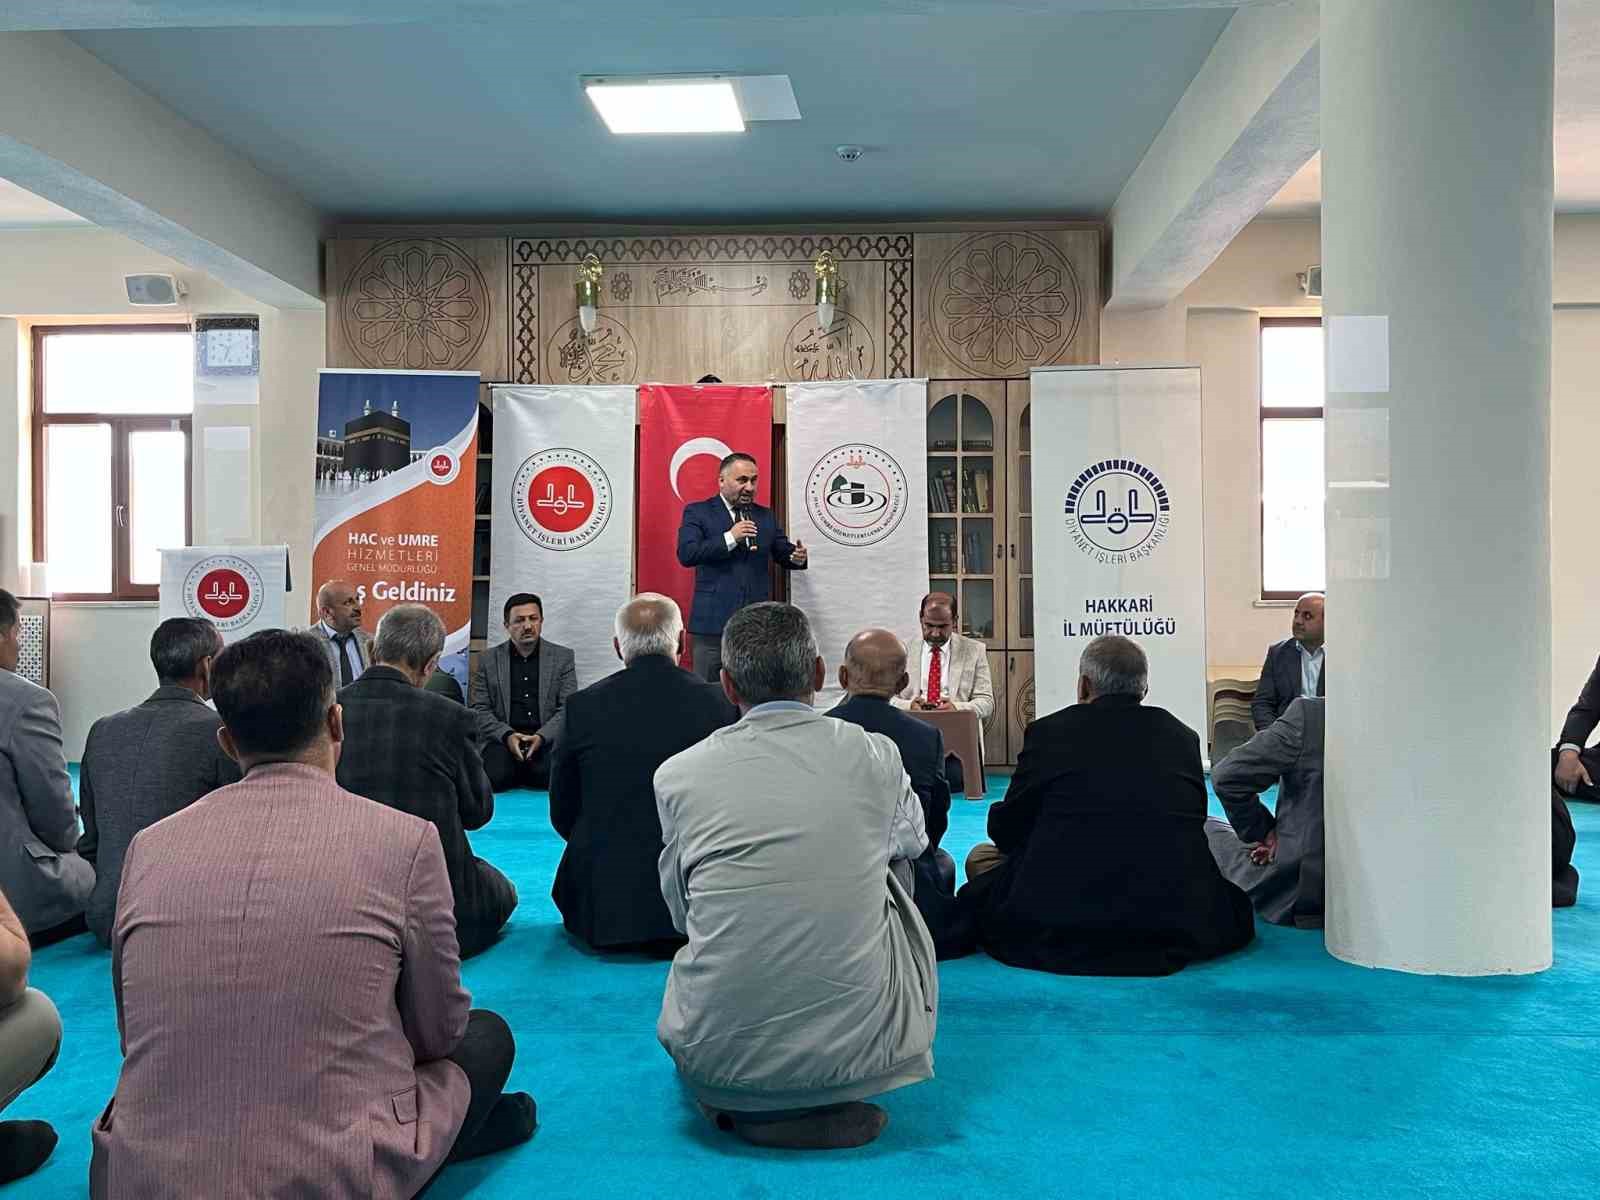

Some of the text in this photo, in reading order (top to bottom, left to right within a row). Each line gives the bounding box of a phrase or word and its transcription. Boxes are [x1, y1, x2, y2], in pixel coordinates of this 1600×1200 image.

[515, 498, 607, 545] DİYANET İŞLERİ BAŞKANLIĞI
[348, 532, 439, 547] HAC ve UMRE
[1064, 512, 1171, 565] DİYANET İŞLERİ BAŞKANLIĞI
[347, 548, 439, 562] HİZMETLERİ
[347, 562, 438, 574] GENEL MÜDÜRLÜĞÜ
[372, 580, 456, 603] Geldiniz
[1085, 594, 1154, 614] HAKKARİ
[1063, 617, 1176, 637] İL MÜFTÜLÜĞÜ
